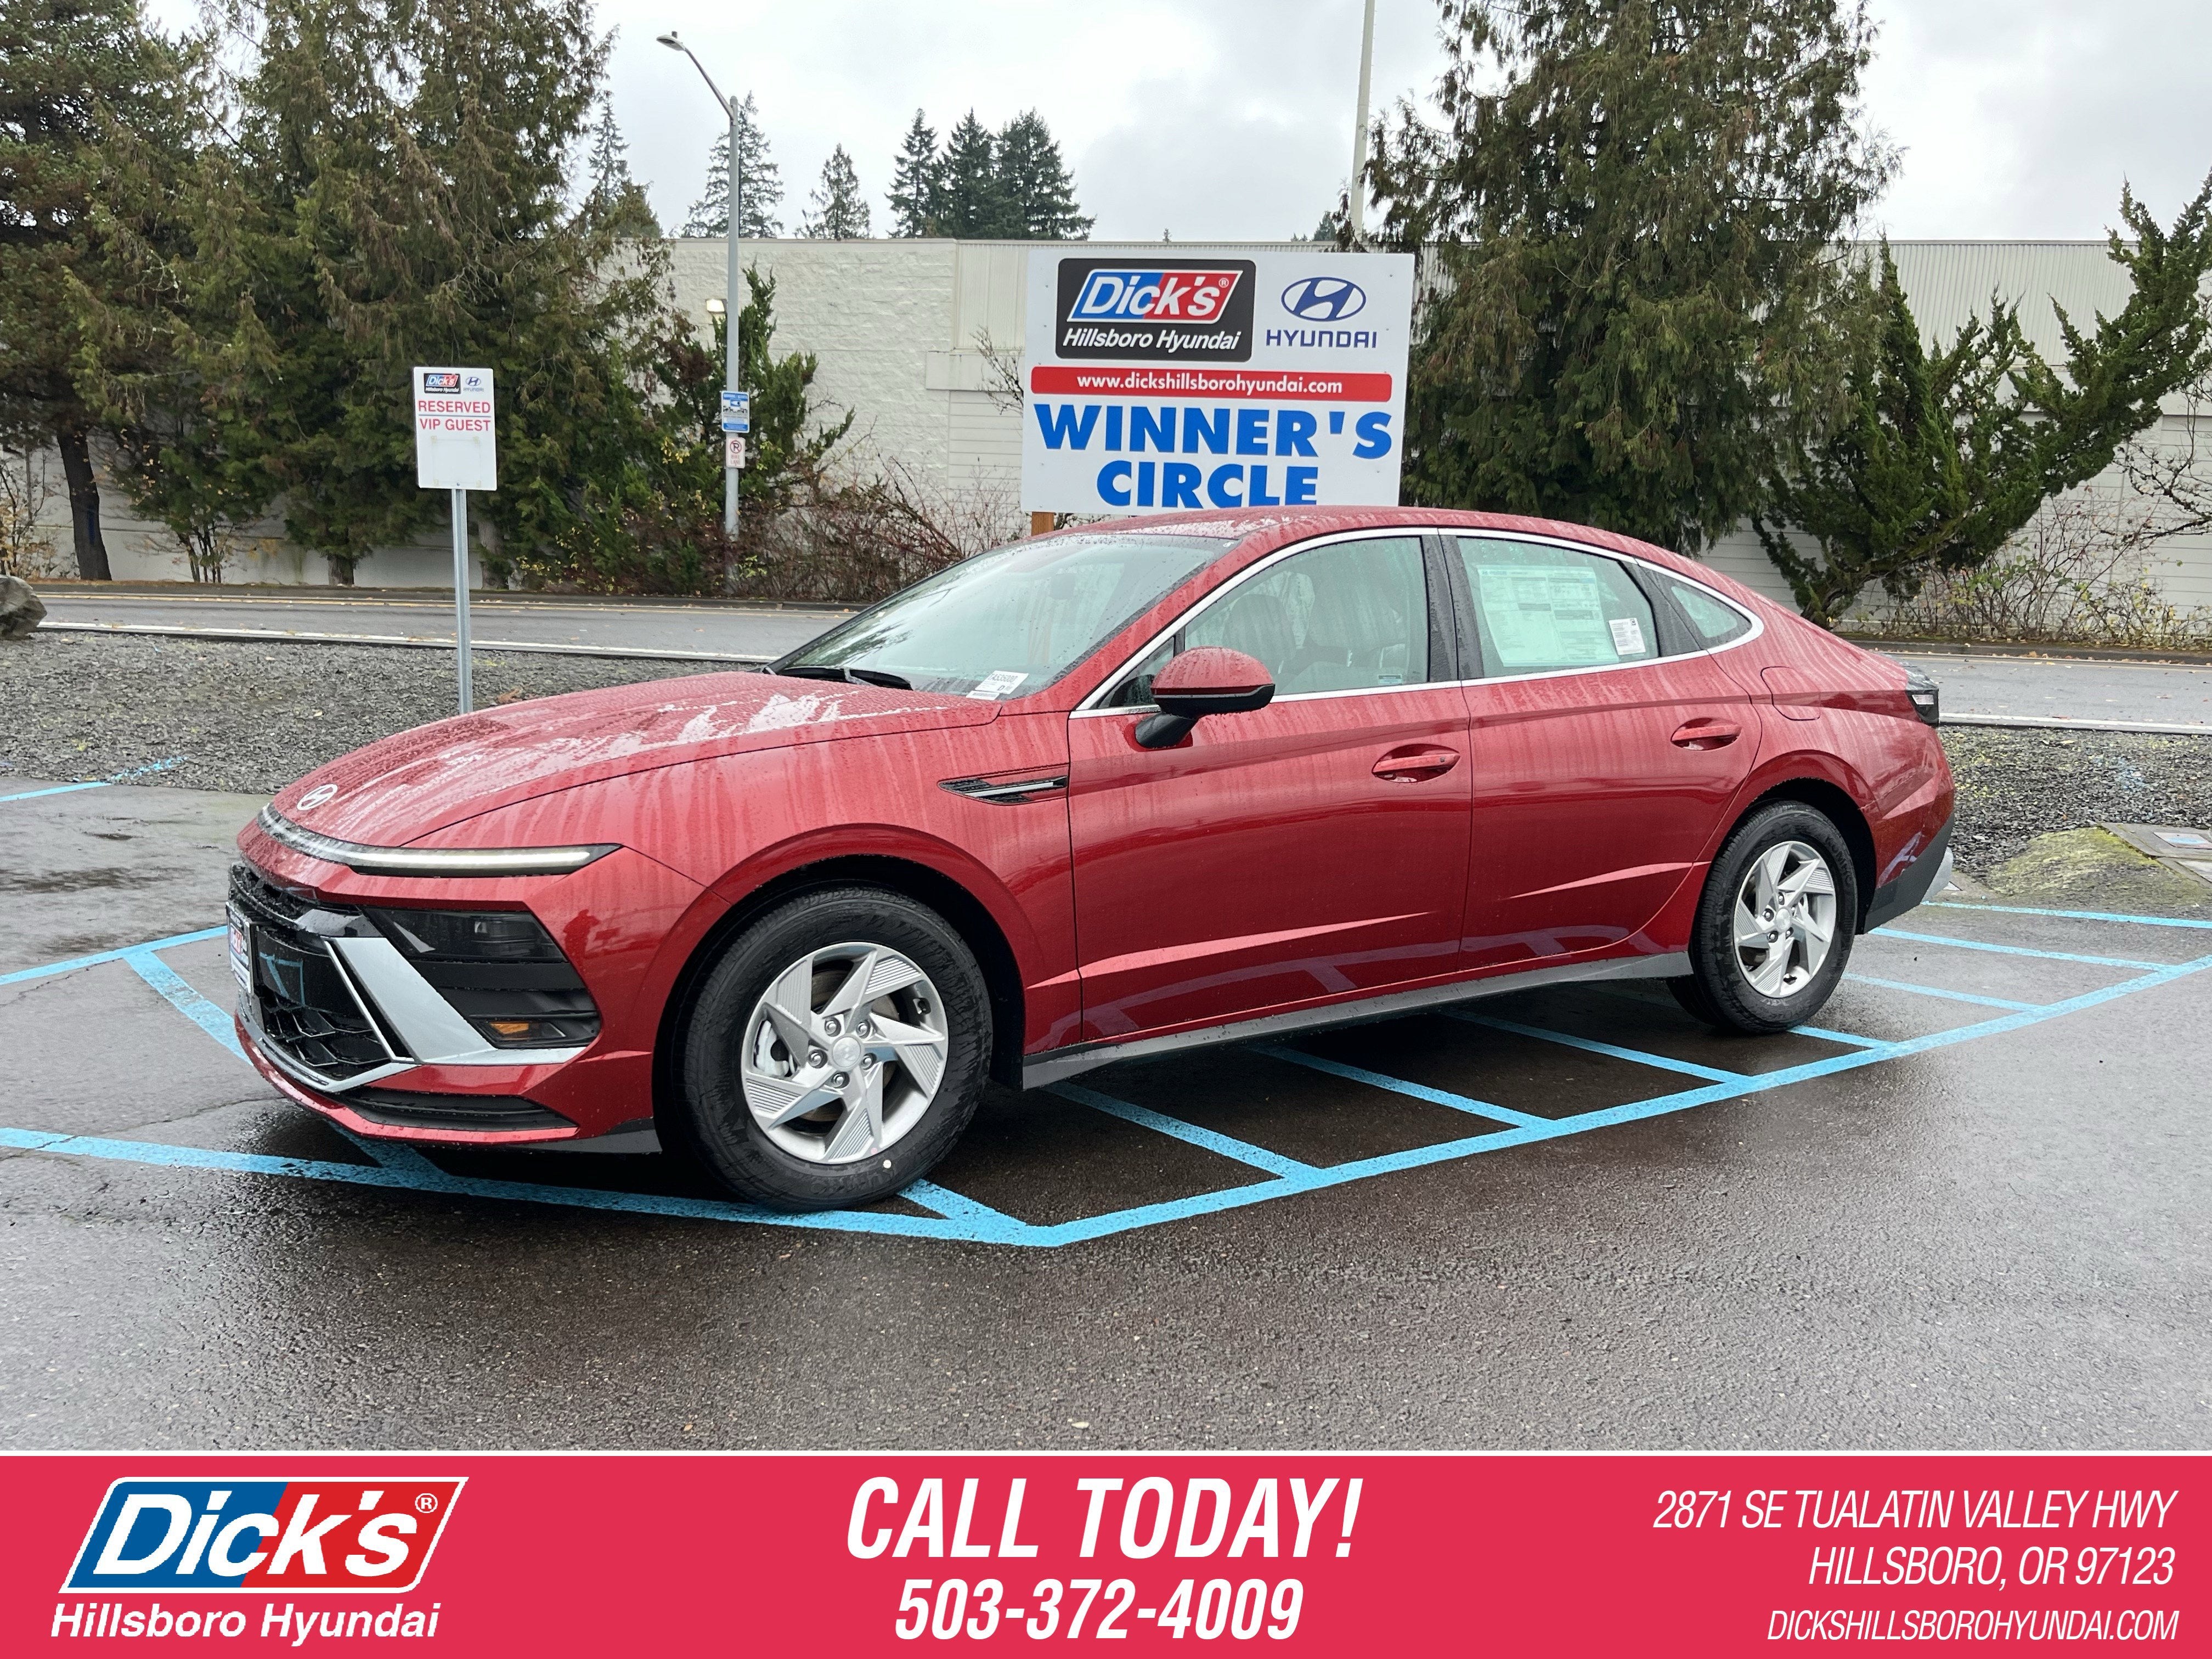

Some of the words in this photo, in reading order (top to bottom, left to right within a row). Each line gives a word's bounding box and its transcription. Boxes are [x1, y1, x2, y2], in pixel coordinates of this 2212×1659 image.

[1062, 328, 1153, 348] Hillsboro
[1156, 330, 1242, 353] Hyundai
[1266, 330, 1378, 349] HYUNDAI
[1077, 374, 1342, 396] www.dickshillsborohyundai.com
[419, 400, 490, 414] RESERVED
[420, 419, 441, 430] VIP
[445, 419, 491, 432] GUEST
[1034, 404, 1392, 460] WINNER'S
[1096, 460, 1319, 509] CIRCLE
